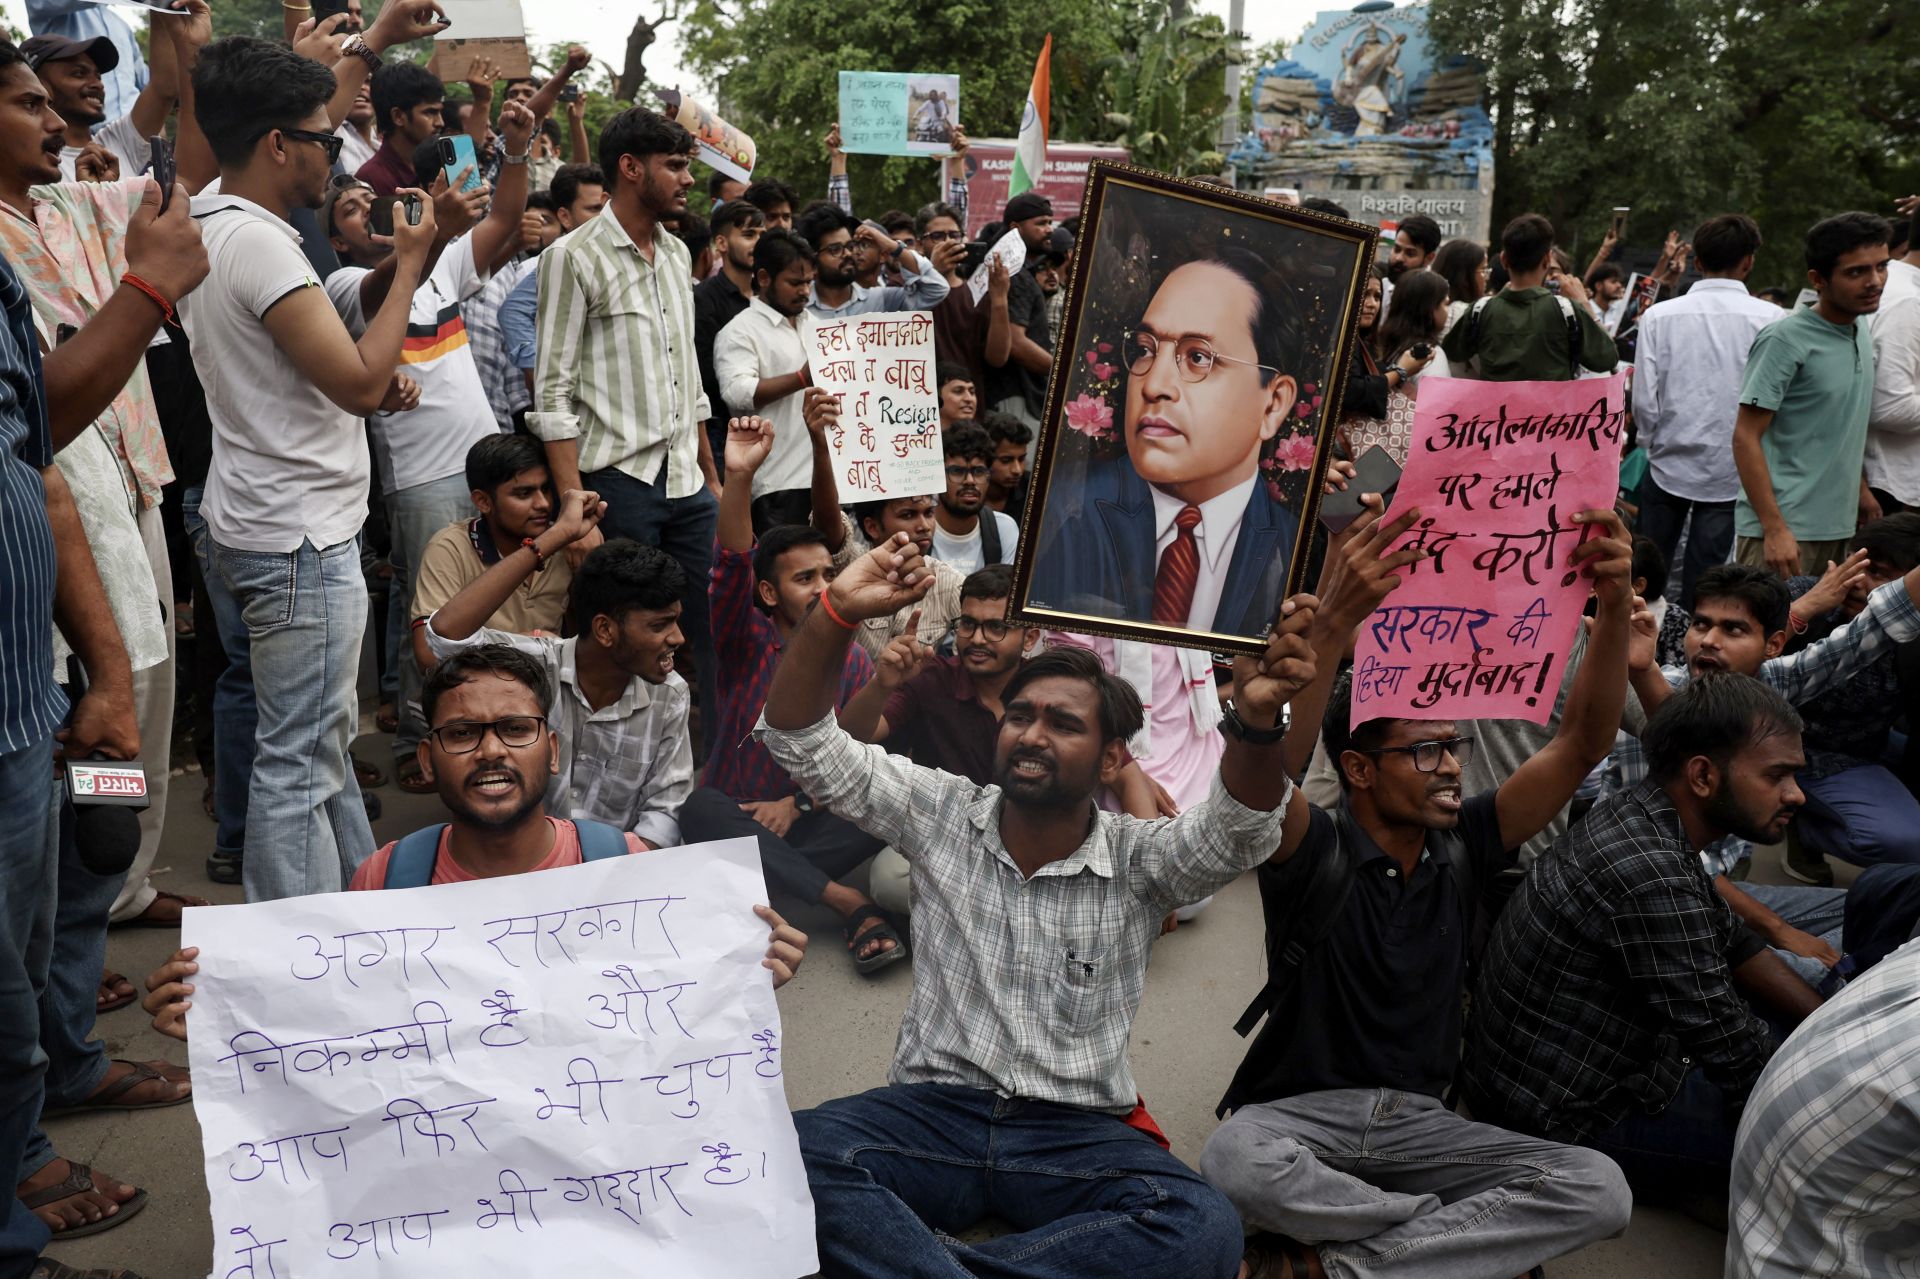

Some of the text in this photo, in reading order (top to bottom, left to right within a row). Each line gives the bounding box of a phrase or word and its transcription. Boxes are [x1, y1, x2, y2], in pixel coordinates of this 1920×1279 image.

[982, 159, 1013, 170] KASH
[1055, 161, 1089, 172] SUMM
[1361, 194, 1466, 215] विश्वविद्यालय
[819, 360, 857, 383] चला
[885, 360, 932, 395] बाबू
[858, 421, 876, 452] के
[878, 396, 938, 435] Resign
[1426, 397, 1624, 453] आंदोलनकारिय
[848, 459, 887, 493] बाबू
[1434, 452, 1576, 511] पर हमले
[1371, 597, 1553, 653] सरकार की
[78, 777, 141, 793] भारत 24
[291, 896, 687, 988] अगर सरकार
[217, 964, 698, 1094] निकम्मी है और
[229, 1027, 783, 1185] आप फिर भी चुप है
[327, 1209, 450, 1261] आप
[476, 1169, 549, 1233] भी
[554, 1161, 693, 1225] गद्दार
